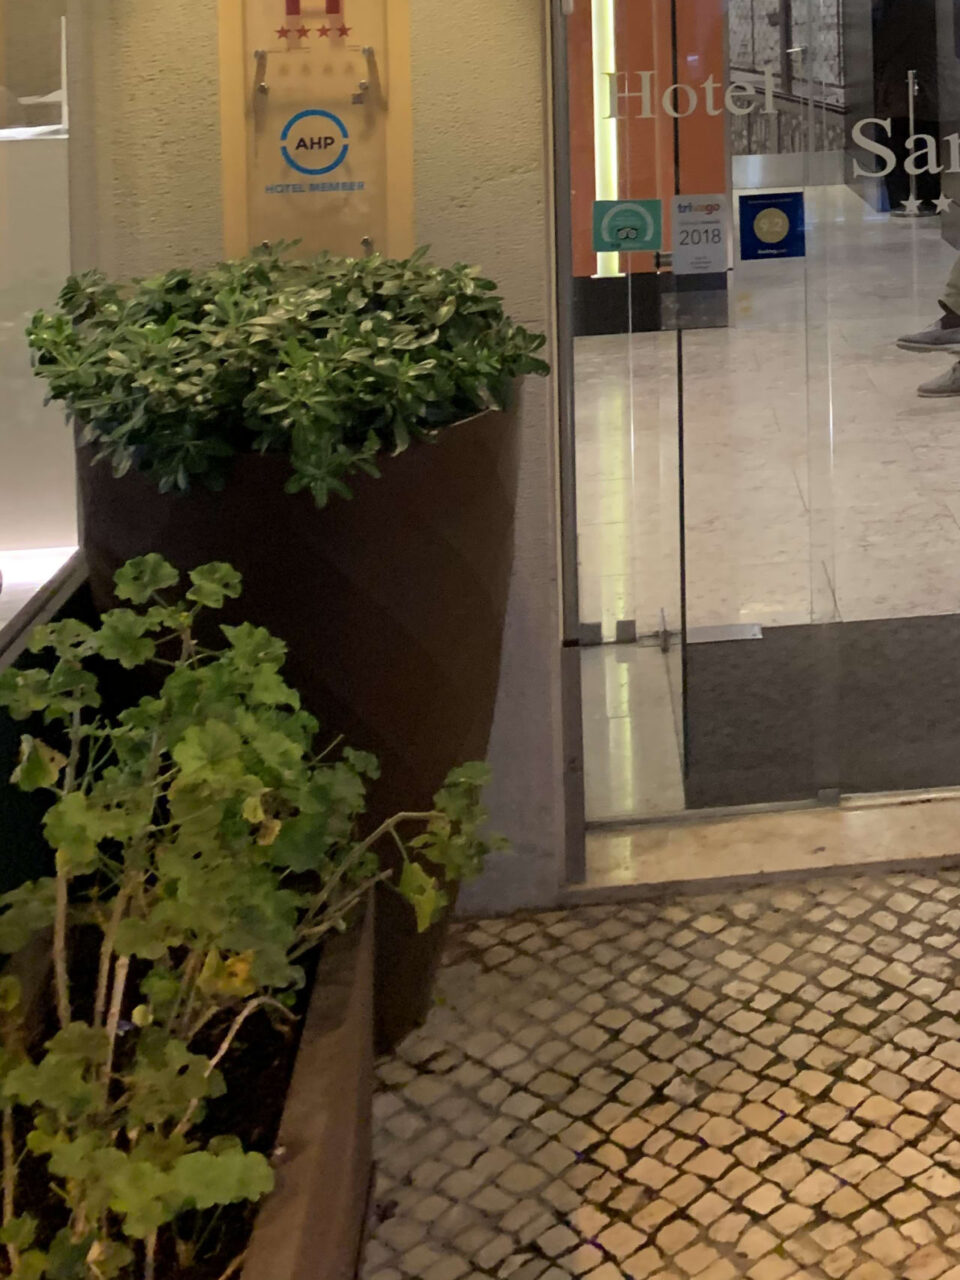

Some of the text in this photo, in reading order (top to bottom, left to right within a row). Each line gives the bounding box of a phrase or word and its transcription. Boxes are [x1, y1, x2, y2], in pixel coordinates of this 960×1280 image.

[600, 66, 779, 121] Hotel
[295, 136, 335, 151] AHP
[265, 181, 364, 194] HOTEL MEMBER
[679, 228, 722, 246] 2018
